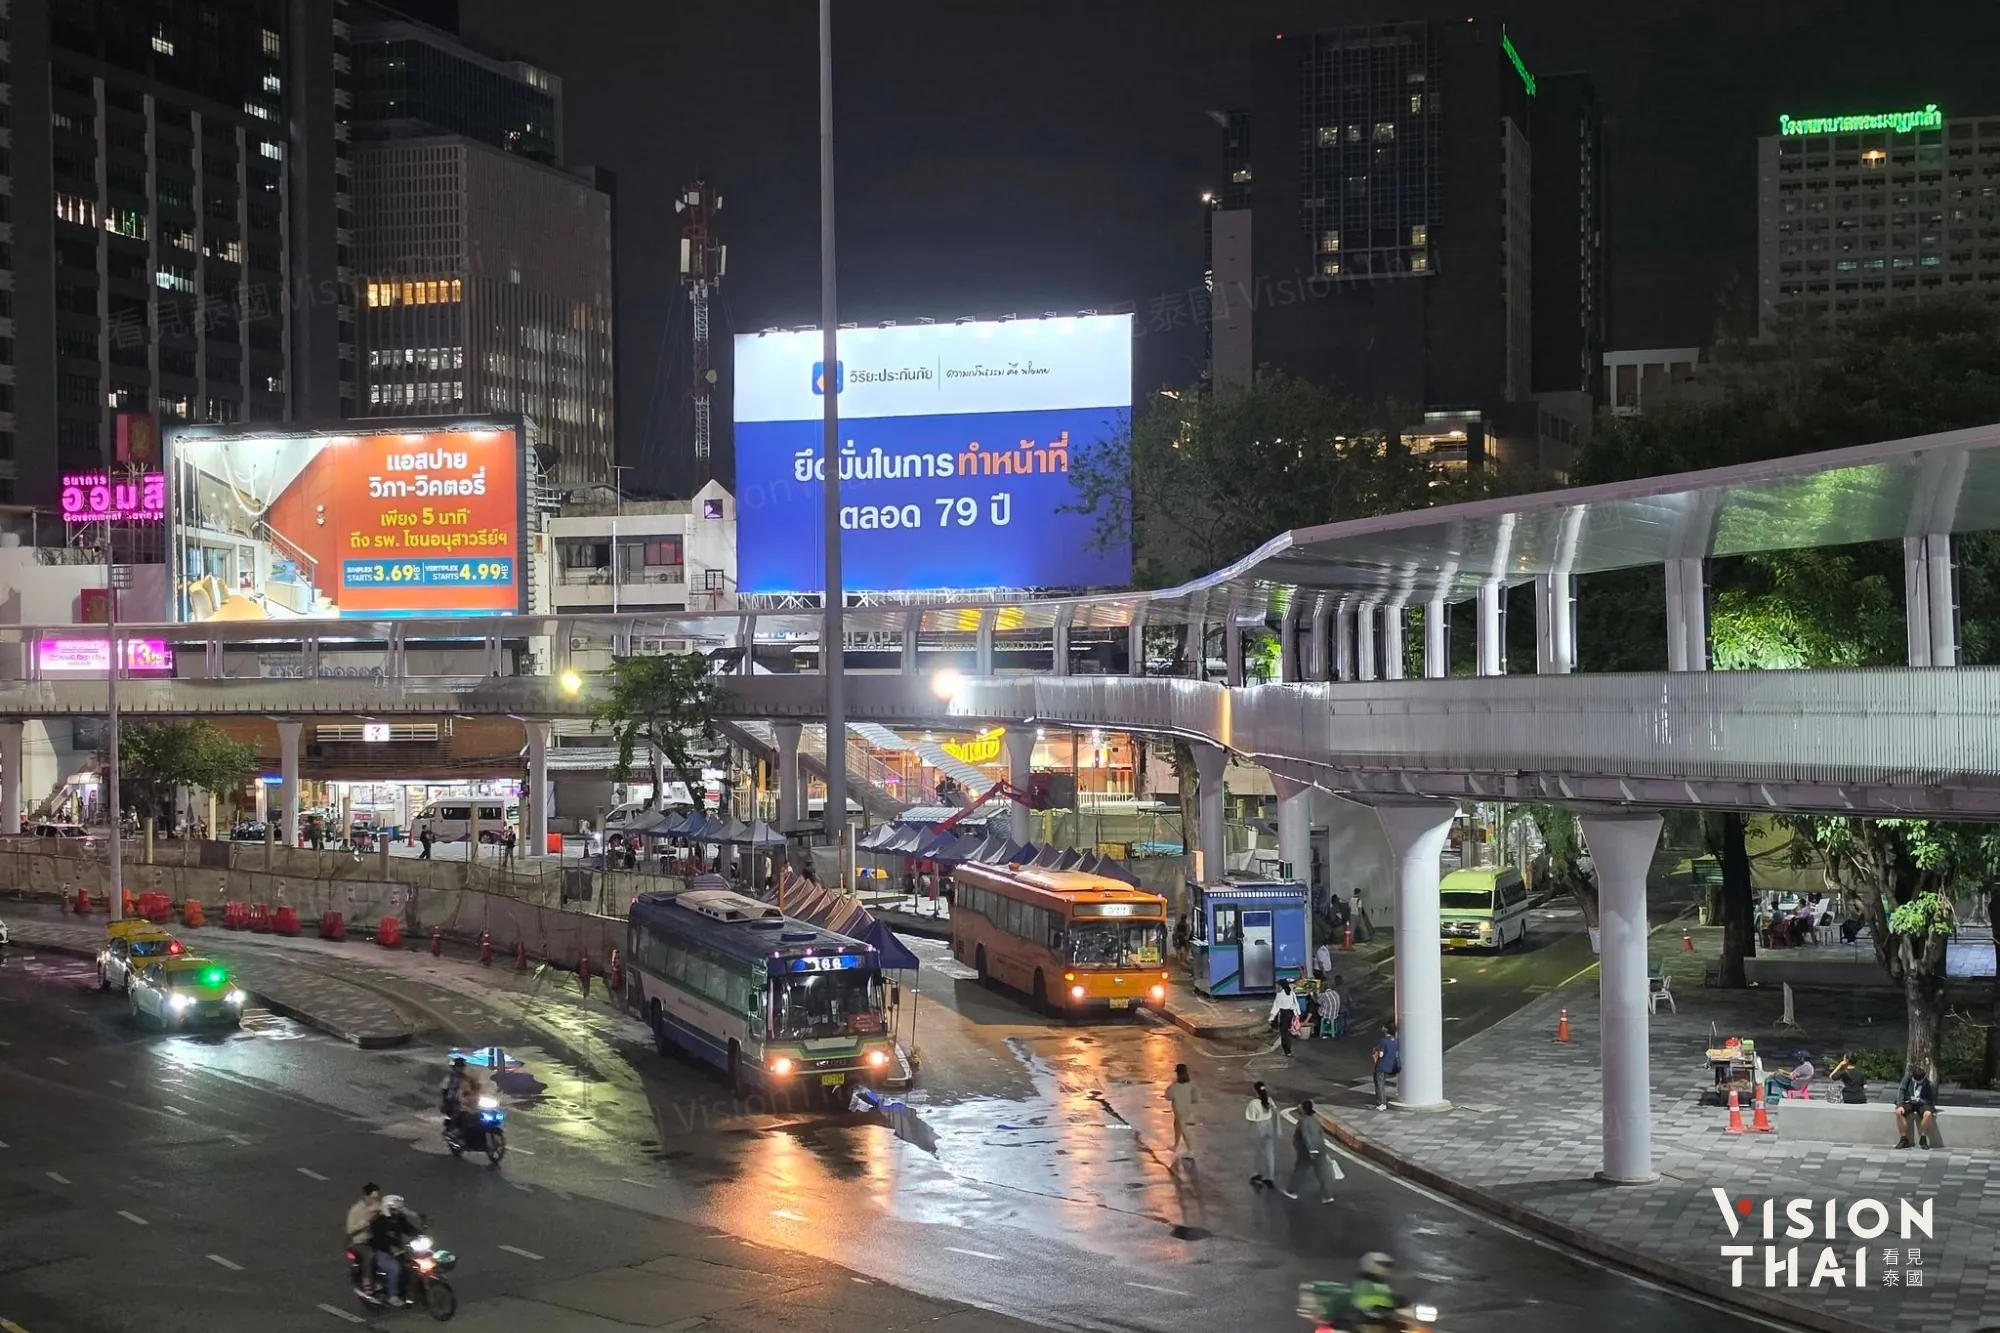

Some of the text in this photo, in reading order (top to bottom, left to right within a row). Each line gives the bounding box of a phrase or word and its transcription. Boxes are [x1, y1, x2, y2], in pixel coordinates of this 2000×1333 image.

[849, 366, 933, 383] วิริยะประกันภัย
[386, 448, 468, 471] แอสปาย
[369, 466, 486, 498] วิภา-วิคตอรี่
[62, 475, 164, 512] ออมสิ
[63, 512, 122, 522] Government
[381, 510, 418, 526] เพียง
[422, 507, 435, 526] 5
[839, 492, 1010, 531] ตลอด 79 ปี
[350, 532, 370, 548] ถึง
[374, 535, 399, 548] รพ.
[347, 574, 373, 582] STARTS
[373, 564, 414, 582] 3.69
[432, 573, 458, 581] STARTS
[459, 563, 502, 581] 4.99
